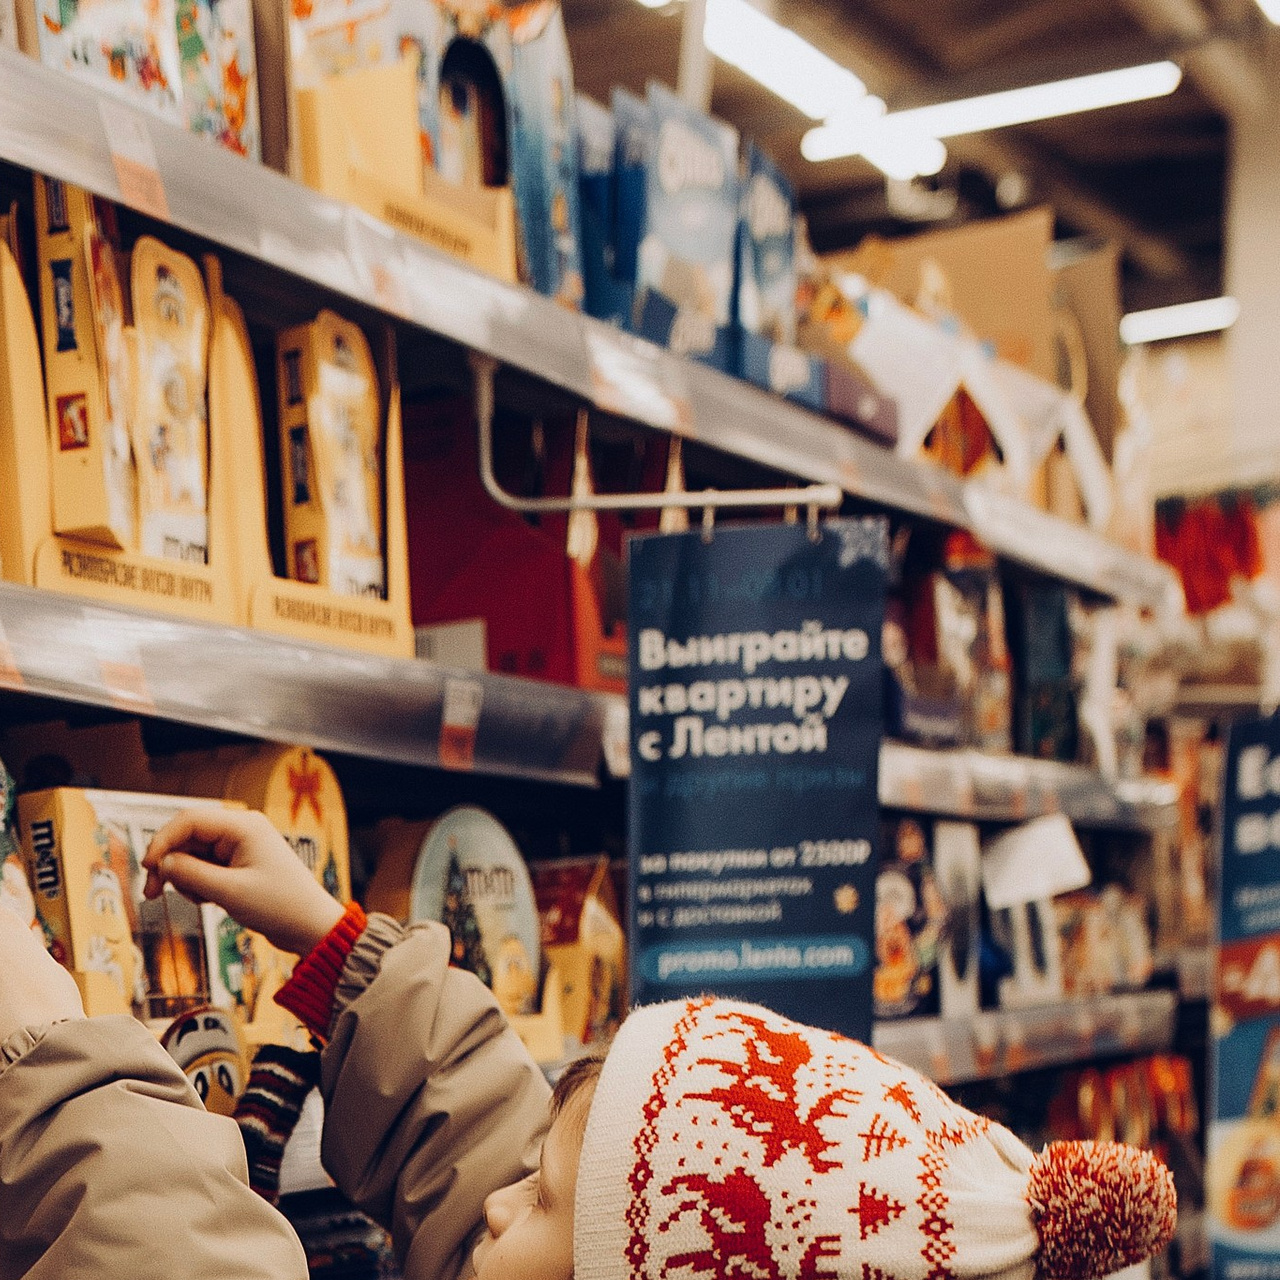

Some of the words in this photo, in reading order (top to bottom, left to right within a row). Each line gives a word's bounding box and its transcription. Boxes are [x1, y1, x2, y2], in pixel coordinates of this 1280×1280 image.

[638, 619, 869, 674] Выиграйте
[638, 675, 850, 720] квартиру
[638, 730, 662, 761] с
[670, 713, 828, 759] Лентой
